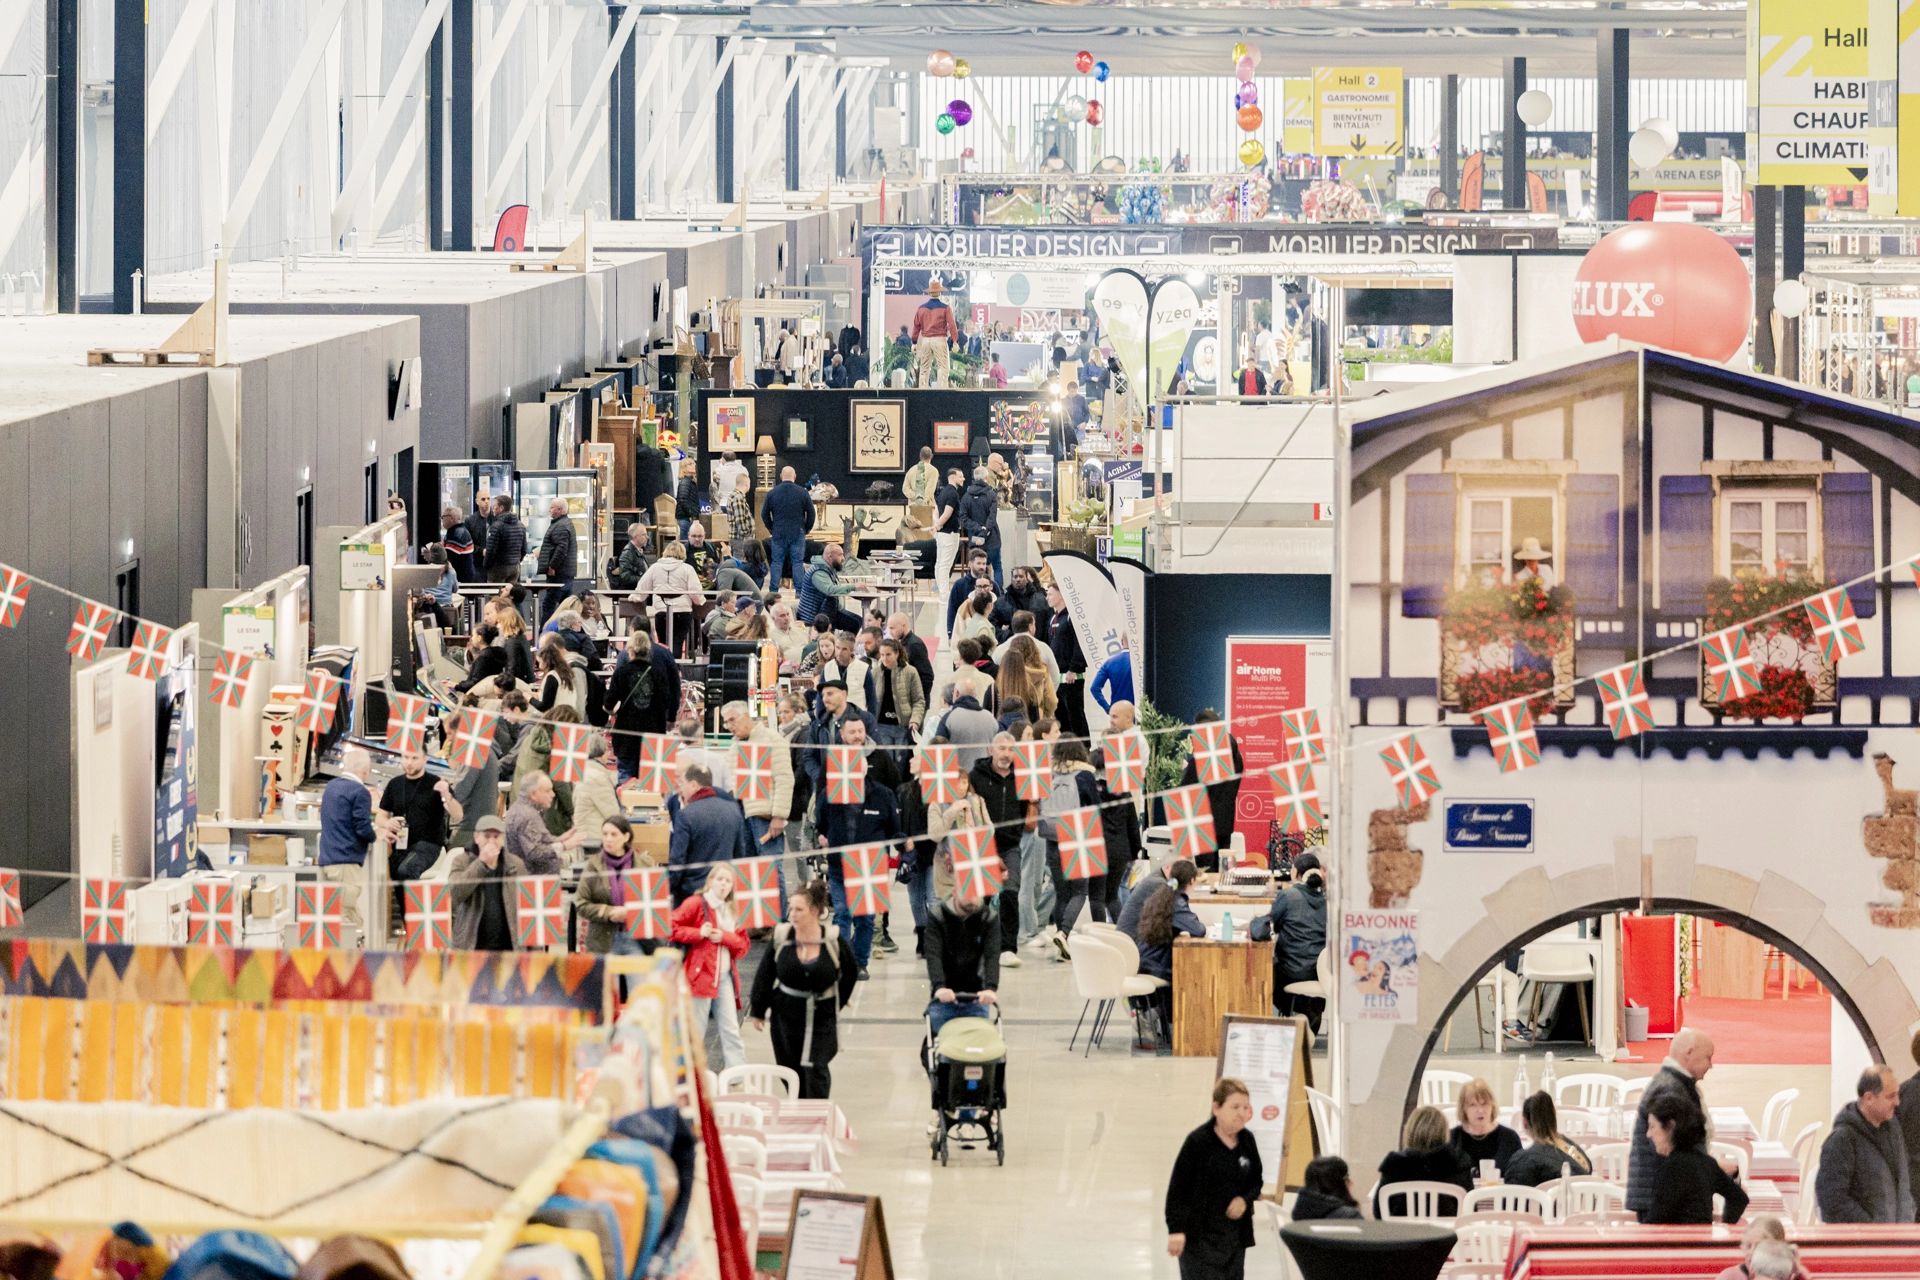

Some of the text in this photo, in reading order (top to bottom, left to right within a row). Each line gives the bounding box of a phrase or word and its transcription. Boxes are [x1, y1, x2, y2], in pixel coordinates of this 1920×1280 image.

[1824, 28, 1867, 47] Hall
[1339, 76, 1376, 86] Hall 2
[1327, 95, 1390, 103] GASTRONOMIE
[1814, 83, 1868, 99] HABI
[1793, 112, 1868, 129] CHAUF
[1776, 142, 1868, 159] CLIMATI
[1655, 170, 1746, 180] ARENA ESPT
[914, 233, 1026, 257] MOBILIER
[1035, 235, 1125, 256] DESIGN
[1390, 234, 1477, 253] DESIGN
[1156, 308, 1191, 325] yzea
[1107, 462, 1131, 479] ACHAT
[1501, 808, 1514, 822] de
[1345, 914, 1417, 929] BAYONNE
